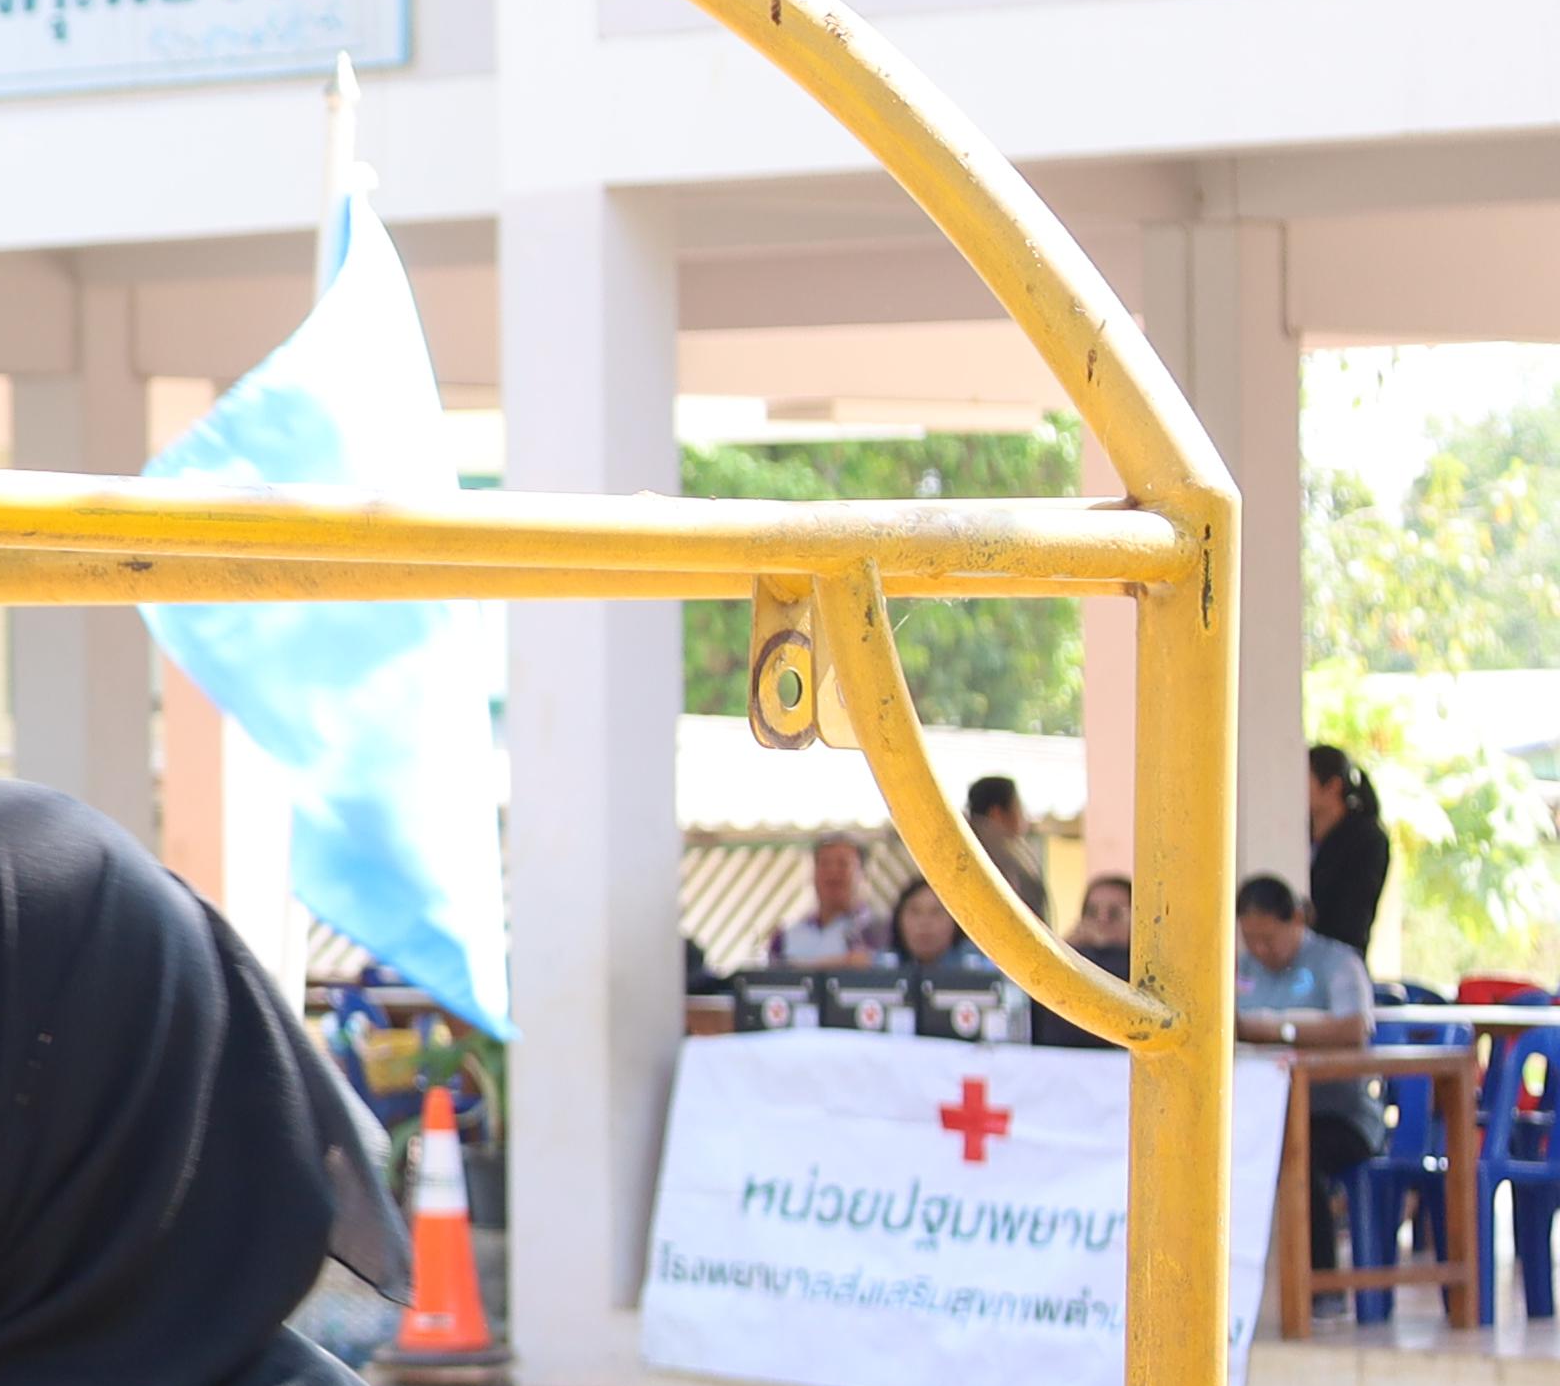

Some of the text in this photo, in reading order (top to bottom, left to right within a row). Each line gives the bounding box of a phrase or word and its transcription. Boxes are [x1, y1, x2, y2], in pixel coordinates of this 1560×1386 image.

[741, 1163, 1124, 1252] หน่วยปฐมพยาบ
